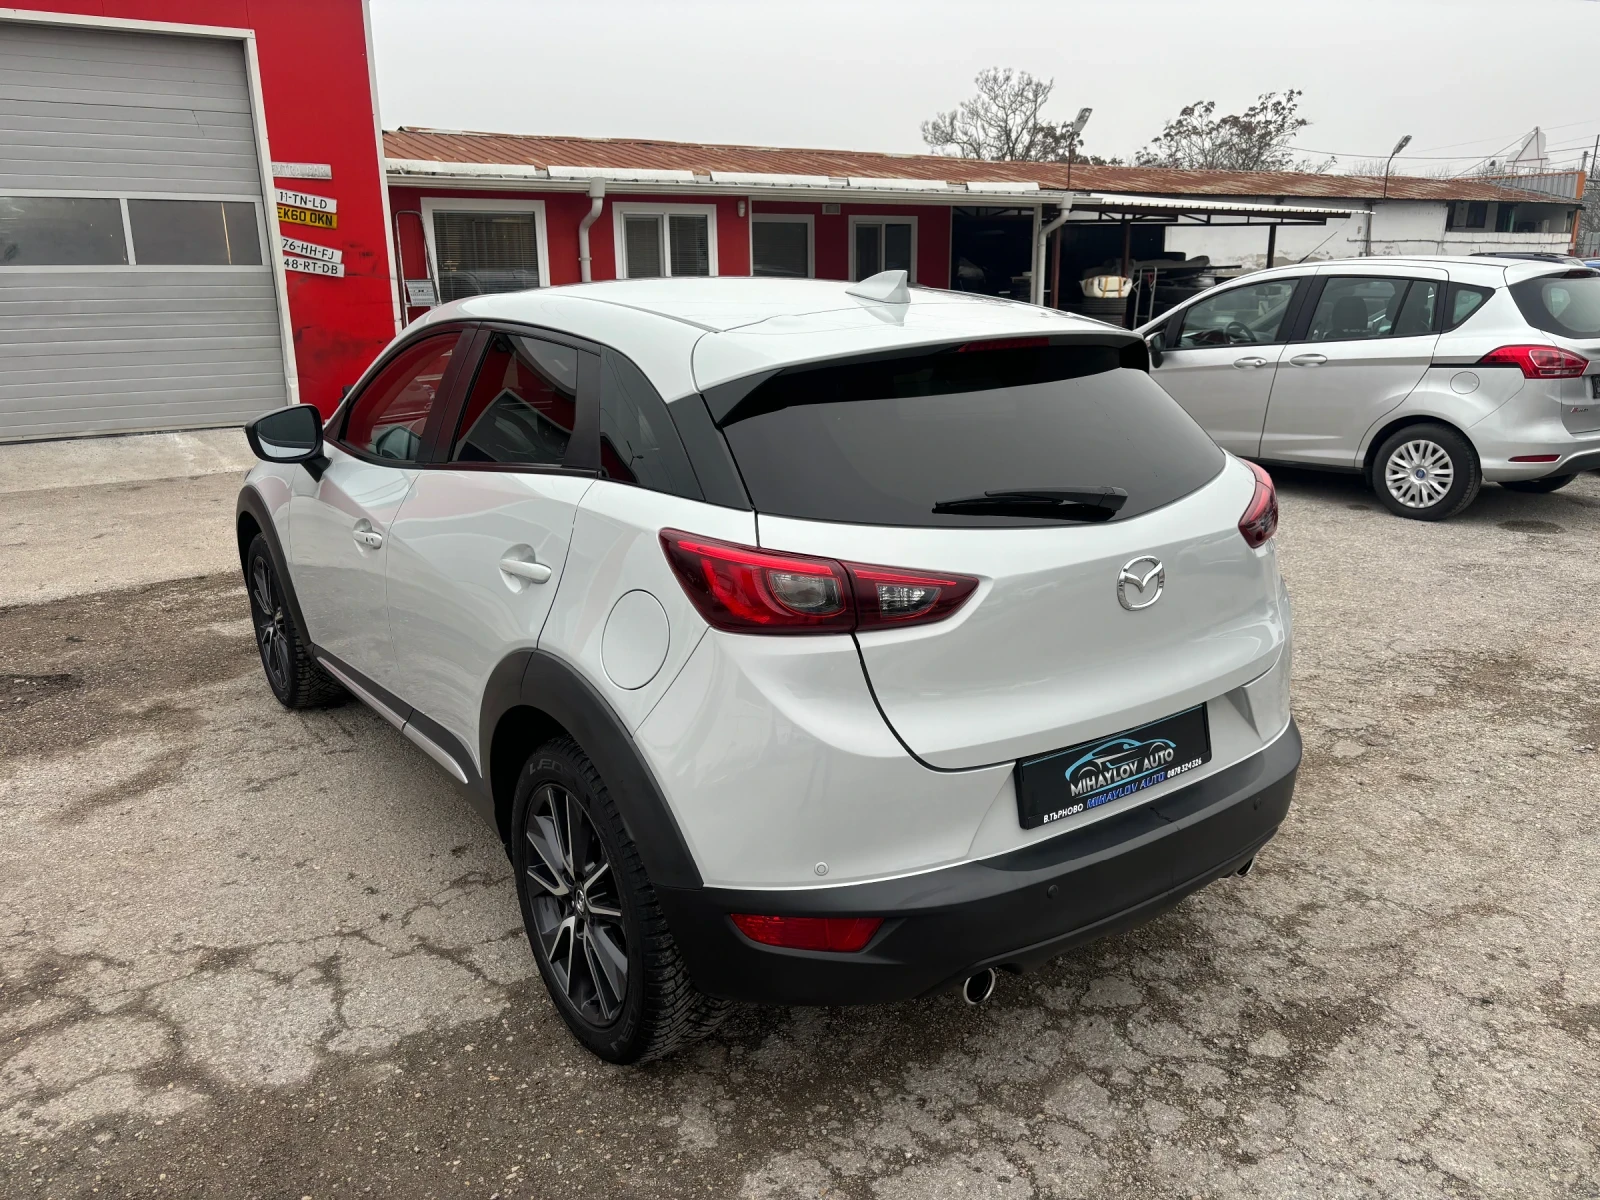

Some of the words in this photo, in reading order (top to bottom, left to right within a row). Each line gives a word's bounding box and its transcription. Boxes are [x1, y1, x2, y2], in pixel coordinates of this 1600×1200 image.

[282, 238, 334, 260] 76-HH-FJ
[284, 258, 338, 275] 48-RT-DB
[1070, 761, 1138, 797] MIHAYLOV
[1143, 748, 1174, 771] AUTO
[1087, 782, 1138, 809] MIHAYLOV
[1140, 771, 1166, 789] AUTO
